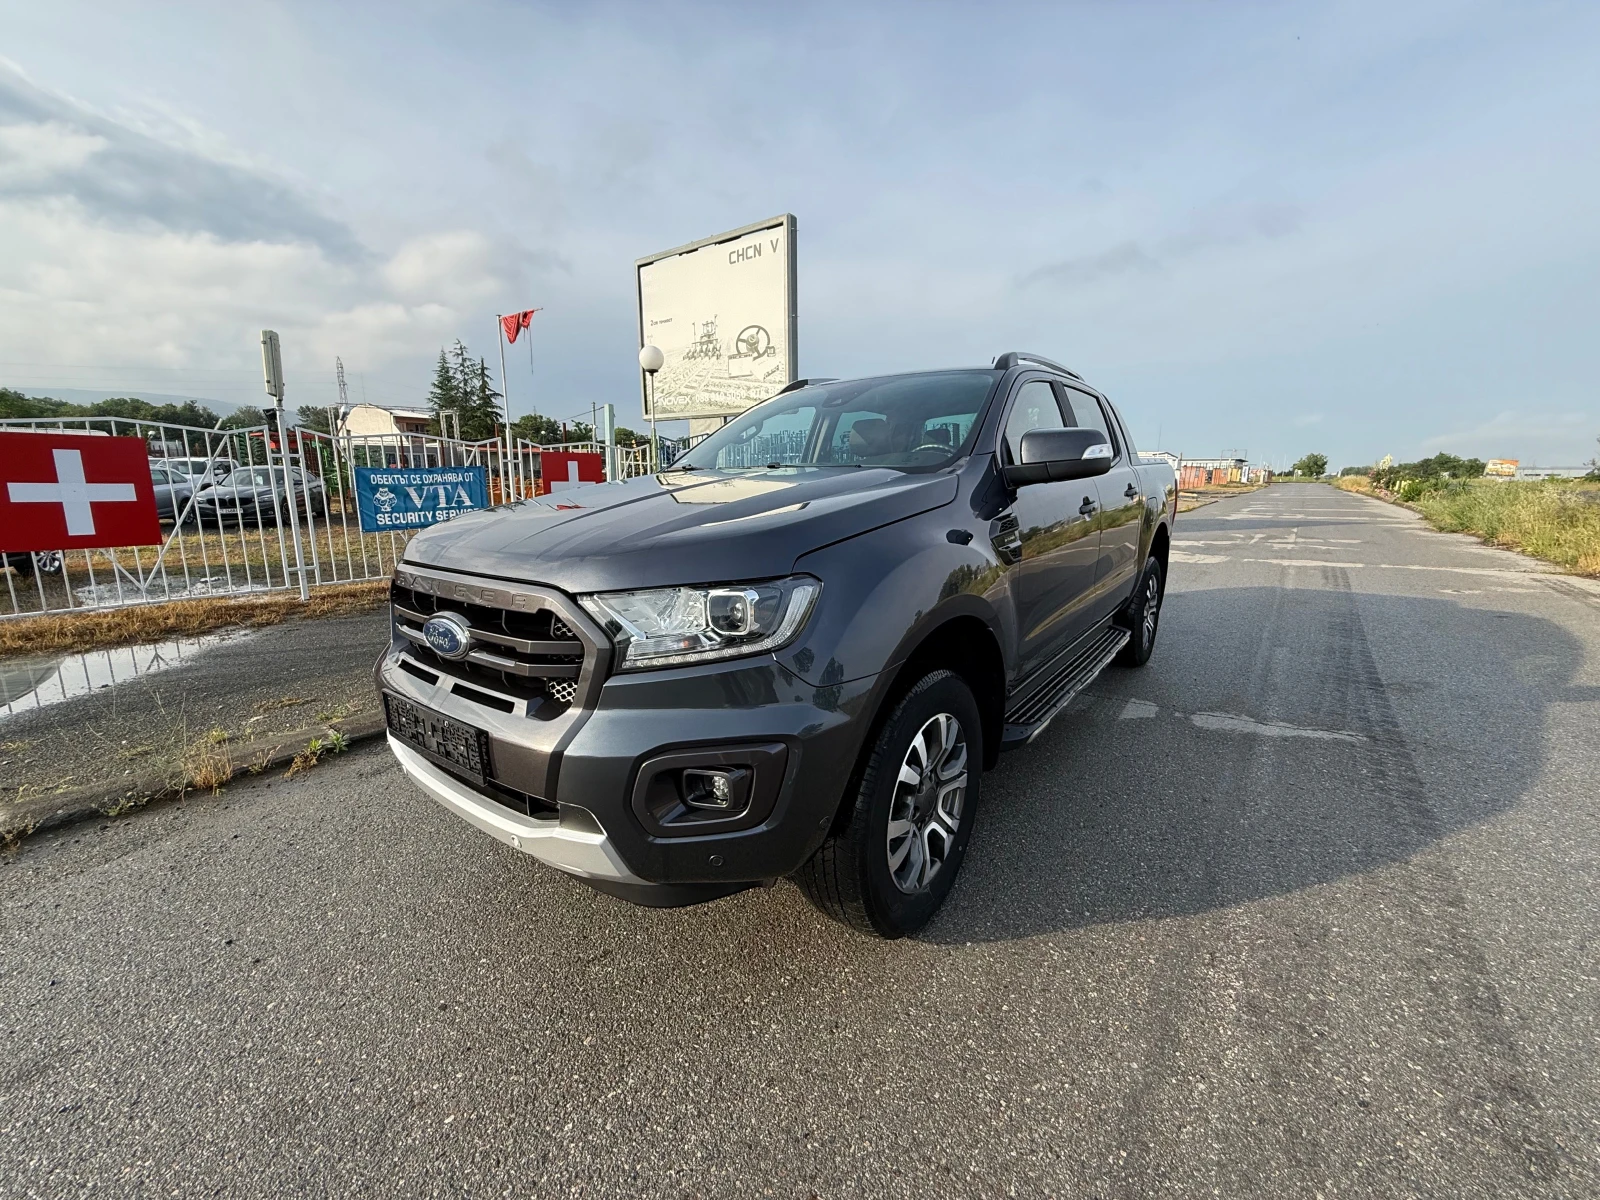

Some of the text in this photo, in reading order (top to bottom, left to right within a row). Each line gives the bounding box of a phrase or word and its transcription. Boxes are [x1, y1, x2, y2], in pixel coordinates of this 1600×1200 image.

[729, 237, 780, 265] CHCN V
[370, 472, 474, 485] ОБЕКТЪТ СЕ ОХРАНЯВА ОТ
[404, 484, 474, 508] VTA
[376, 510, 433, 525] SECURITY
